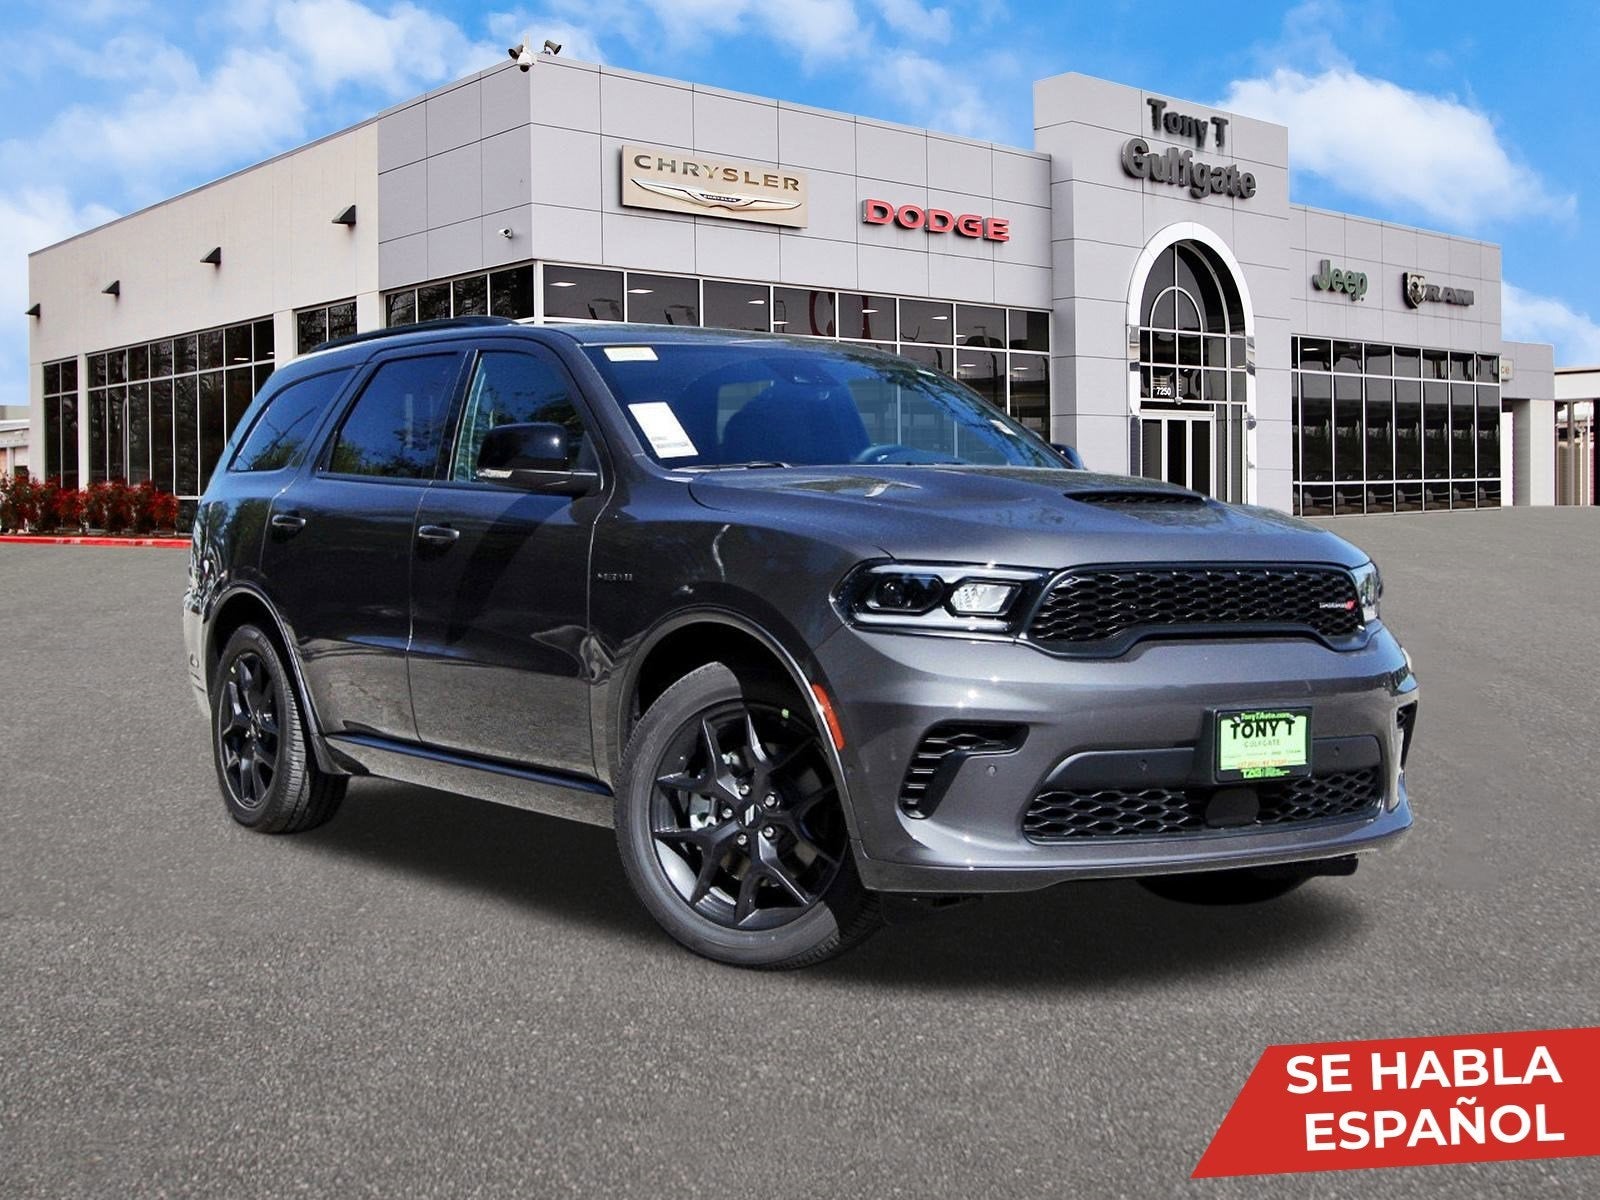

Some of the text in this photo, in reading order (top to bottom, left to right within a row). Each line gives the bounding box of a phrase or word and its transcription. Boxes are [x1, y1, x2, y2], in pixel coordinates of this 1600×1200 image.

[1147, 97, 1230, 148] Tony T
[633, 153, 801, 193] CHRYSLER
[1121, 138, 1257, 199] Gulfgate
[862, 198, 1011, 243] DODGE
[1312, 259, 1369, 302] Jeep
[1424, 283, 1475, 306] RAM
[1155, 386, 1172, 396] 7250
[1230, 718, 1296, 740] TONY T
